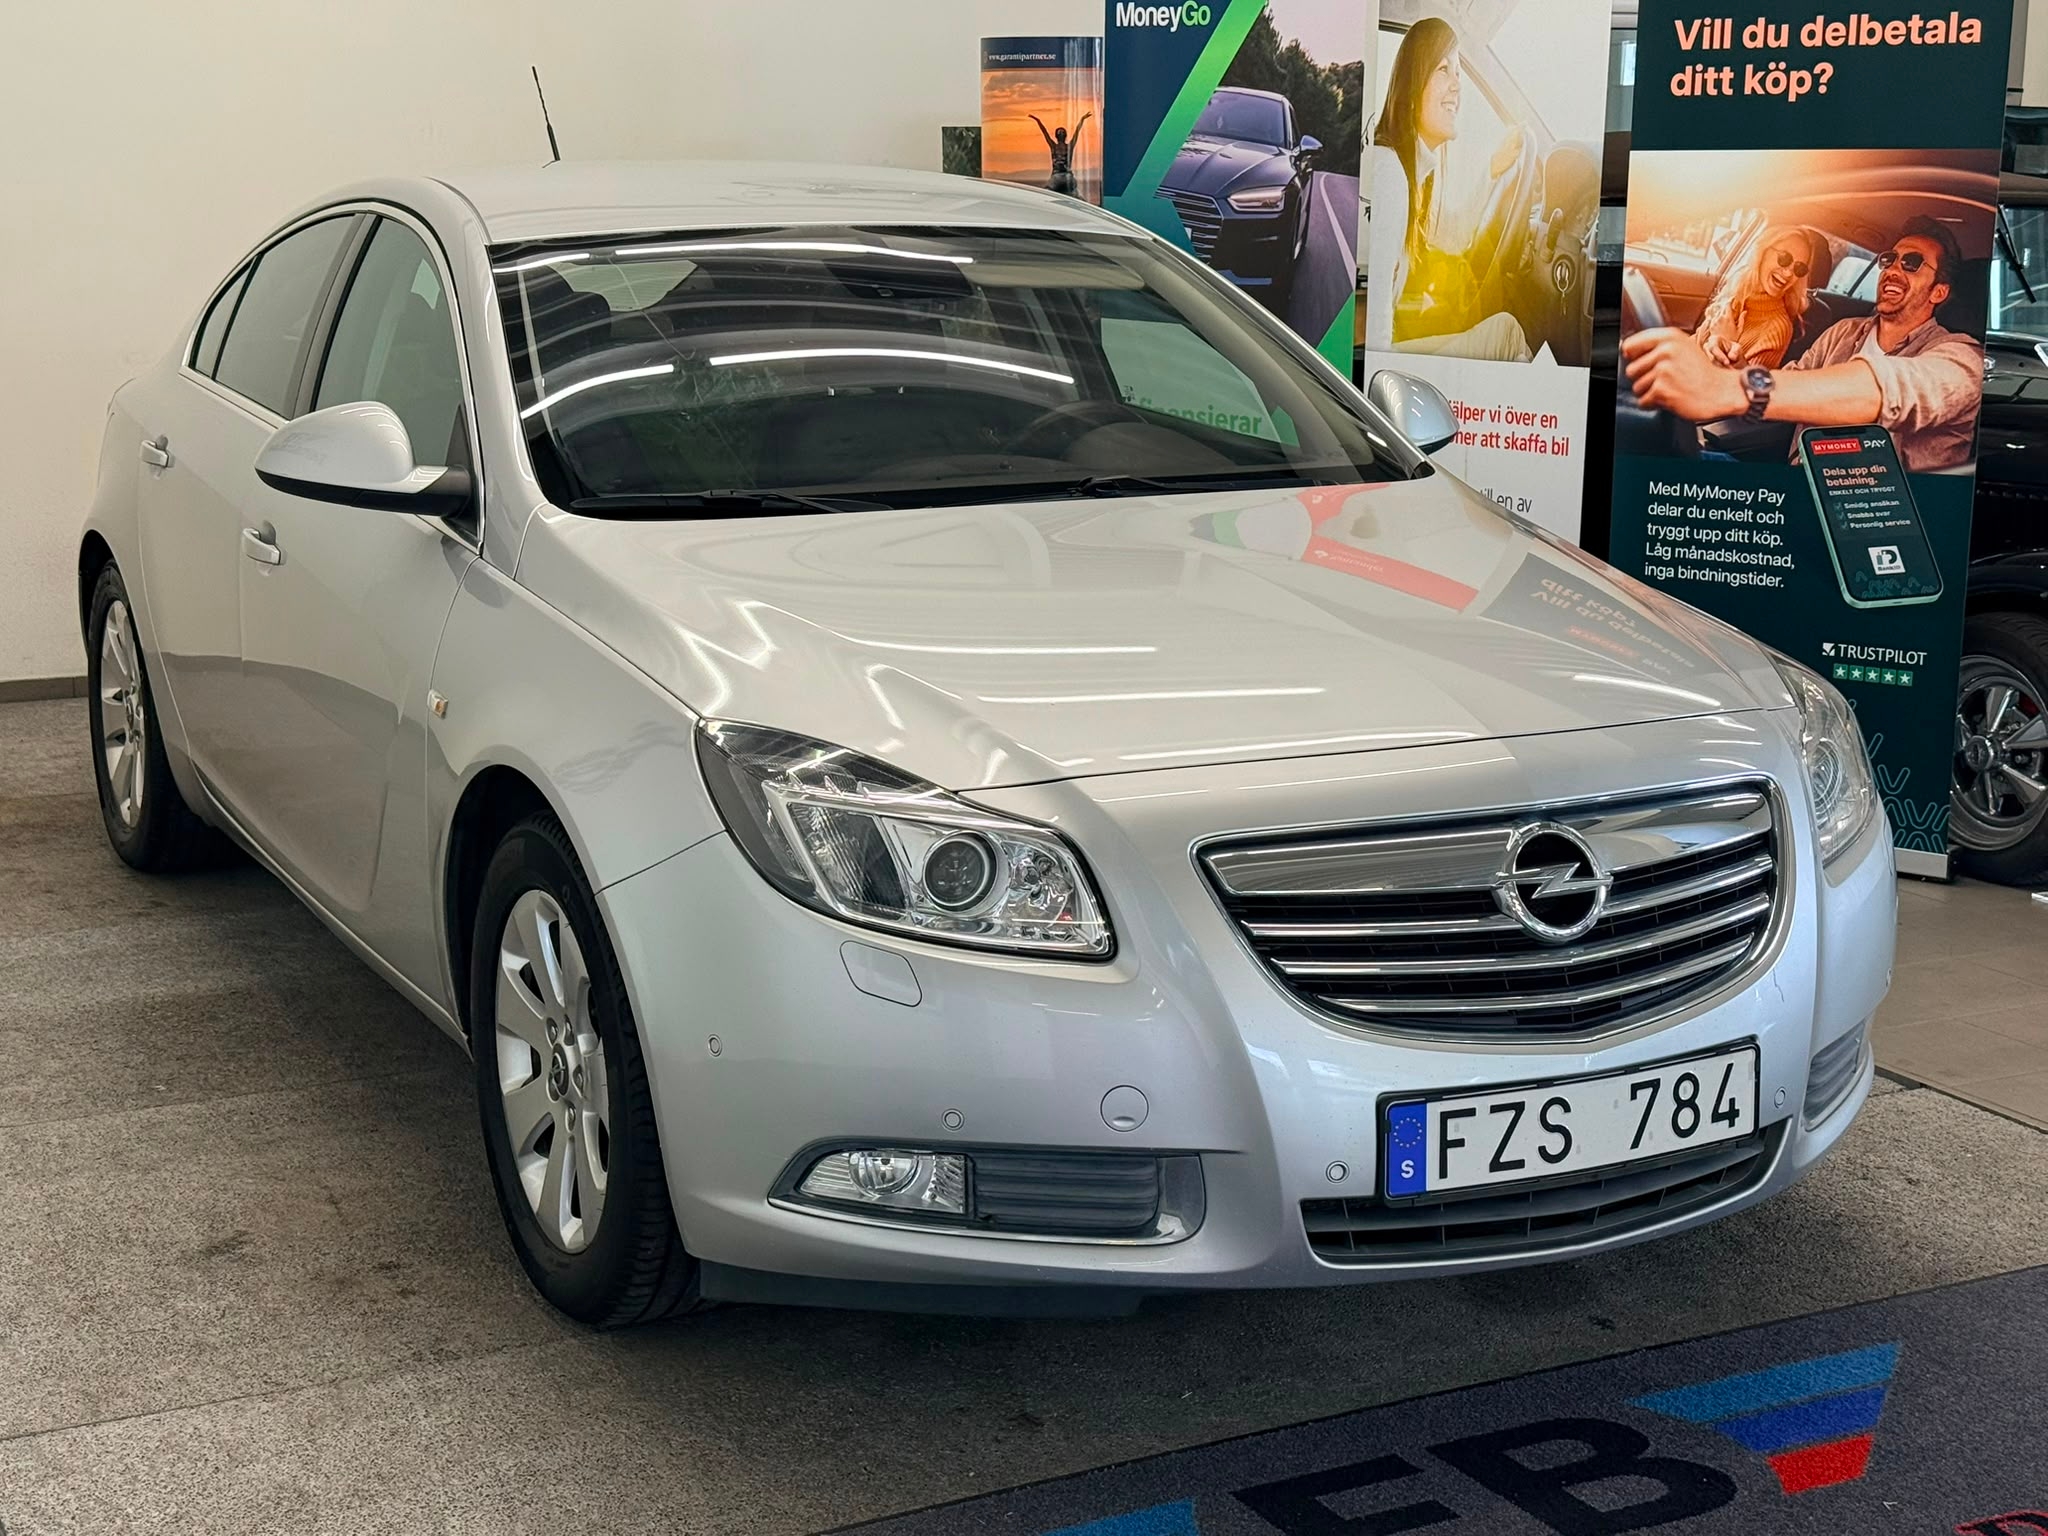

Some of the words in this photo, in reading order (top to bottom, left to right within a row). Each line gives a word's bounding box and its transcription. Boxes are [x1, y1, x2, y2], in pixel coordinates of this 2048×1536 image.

[1116, 0, 1211, 32] MoneyGo
[1674, 17, 1733, 51] Vill
[1742, 17, 1789, 49] du
[1799, 11, 1982, 48] delbetala
[1670, 64, 1734, 96] ditt
[1743, 62, 1834, 102] köp?
[1489, 405, 1501, 423] vi
[1505, 406, 1537, 427] över
[1540, 414, 1558, 429] en
[1480, 431, 1501, 449] att
[1504, 431, 1547, 454] skaffa
[1551, 436, 1569, 456] bil
[1814, 442, 1858, 451] MYMONEY
[1863, 439, 1886, 448] PAY
[1823, 467, 1846, 477] Dela
[1848, 467, 1868, 477] upp
[1870, 464, 1887, 474] din
[1826, 476, 1878, 487] betalning.
[1497, 494, 1513, 510] en
[1517, 498, 1532, 513] av
[1649, 481, 1680, 497] Med
[1683, 483, 1755, 505] MyMoney
[1758, 488, 1785, 507] Pay
[1648, 502, 1684, 517] delar
[1687, 505, 1706, 519] du
[1709, 508, 1753, 522] enkelt
[1756, 511, 1785, 525] och
[1647, 523, 1690, 540] tryggt
[1694, 529, 1721, 543] upp
[1725, 528, 1749, 543] ditt
[1752, 530, 1783, 548] köp.
[1646, 542, 1671, 560] Låg
[1675, 545, 1795, 570] månadskostnad,
[1644, 562, 1674, 580] inga
[1678, 565, 1784, 588] bindningstider.
[1838, 643, 1928, 666] TRUSTPILOT
[1439, 1096, 1574, 1180] FZS
[1629, 1062, 1741, 1151] 784
[1400, 1159, 1415, 1180] S
